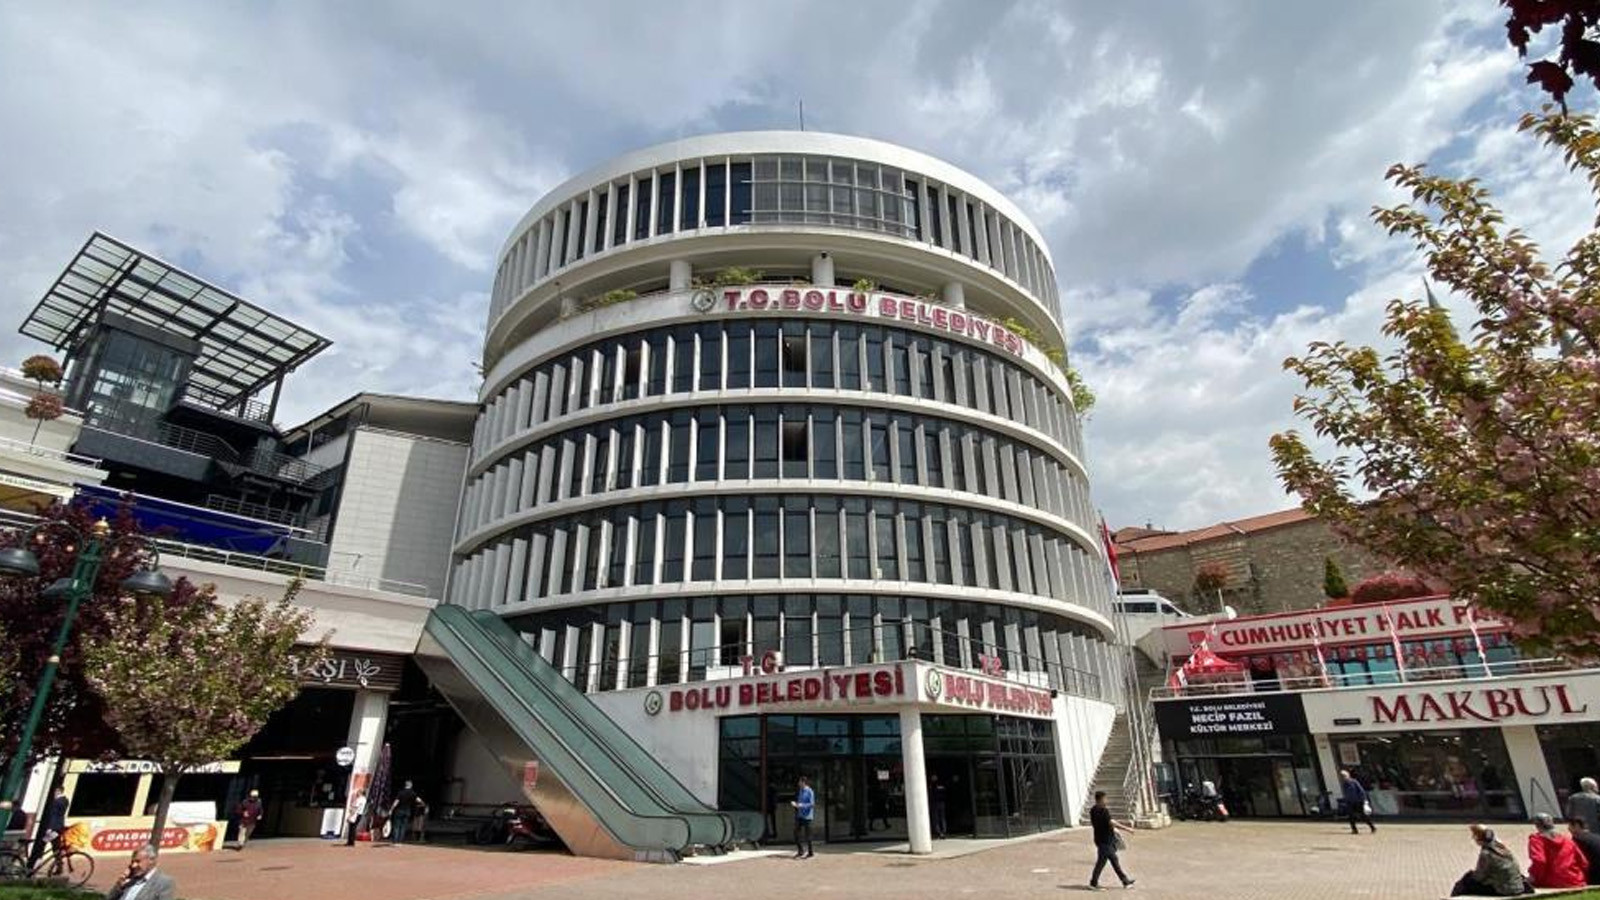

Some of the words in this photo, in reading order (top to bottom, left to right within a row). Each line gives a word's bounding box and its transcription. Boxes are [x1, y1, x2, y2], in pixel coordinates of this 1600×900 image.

[1220, 616, 1367, 646] CUMHURİYET
[1376, 607, 1444, 632] HALK
[669, 685, 731, 712] BOLU
[739, 664, 905, 706] BELEDİYESİ
[943, 673, 984, 708] BOLU
[1367, 684, 1588, 724] MAKBUL
[1192, 710, 1227, 723] NECİP
[1229, 711, 1265, 721] FAZIL
[1203, 704, 1222, 712] BOLU
[1190, 723, 1228, 733] KÜLTÜR
[1229, 721, 1273, 732] MERKEZİ
